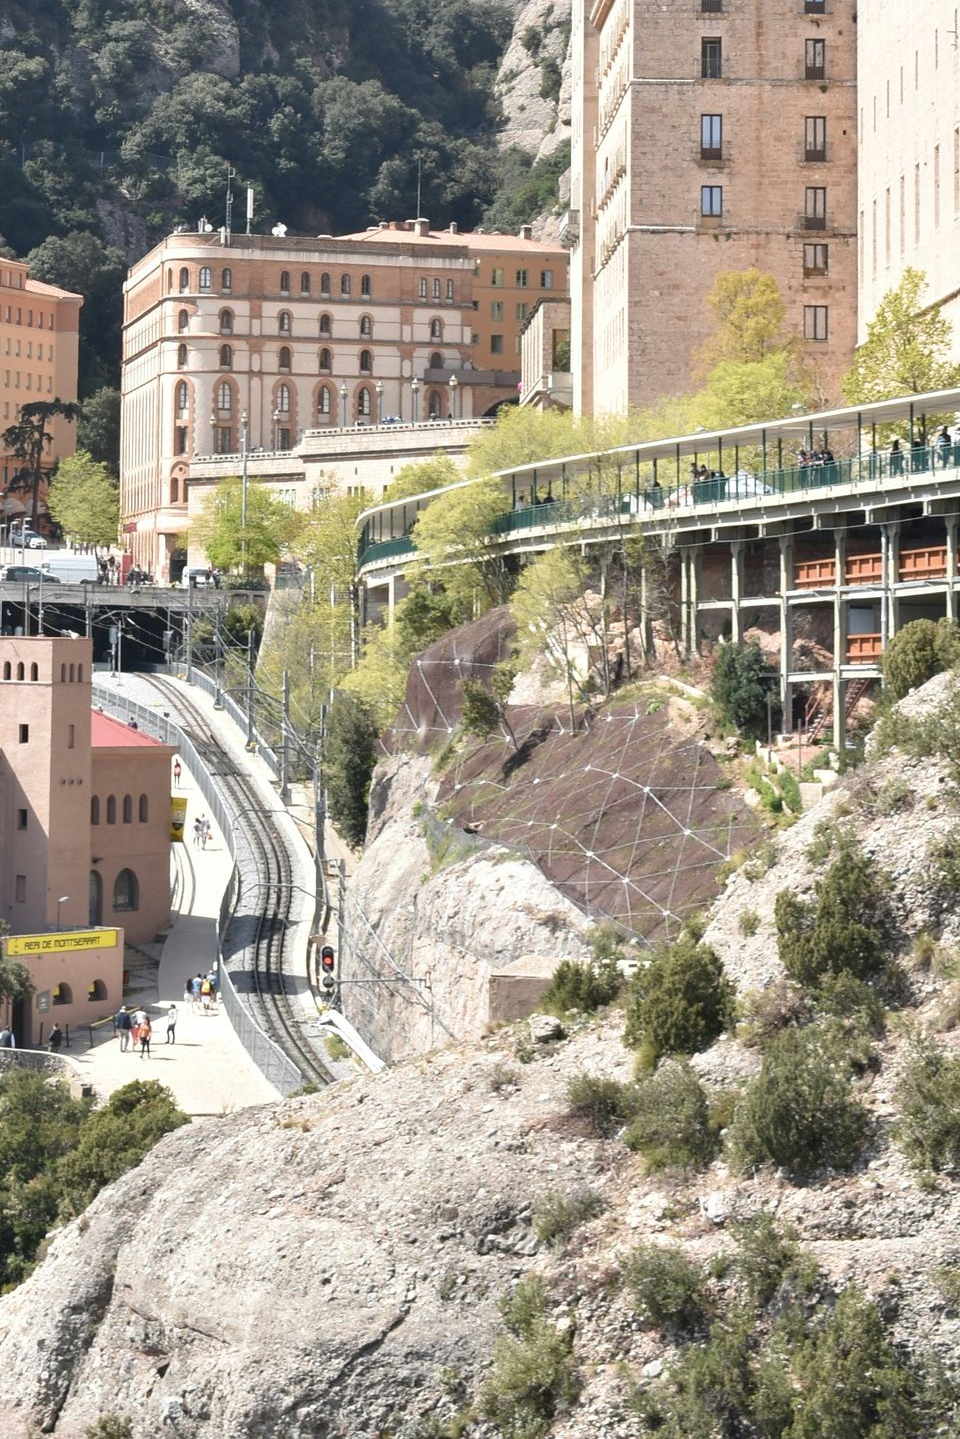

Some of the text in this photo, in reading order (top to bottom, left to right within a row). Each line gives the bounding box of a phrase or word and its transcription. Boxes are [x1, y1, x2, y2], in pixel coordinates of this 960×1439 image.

[24, 936, 101, 950] AERI DE MONTSERRAT
